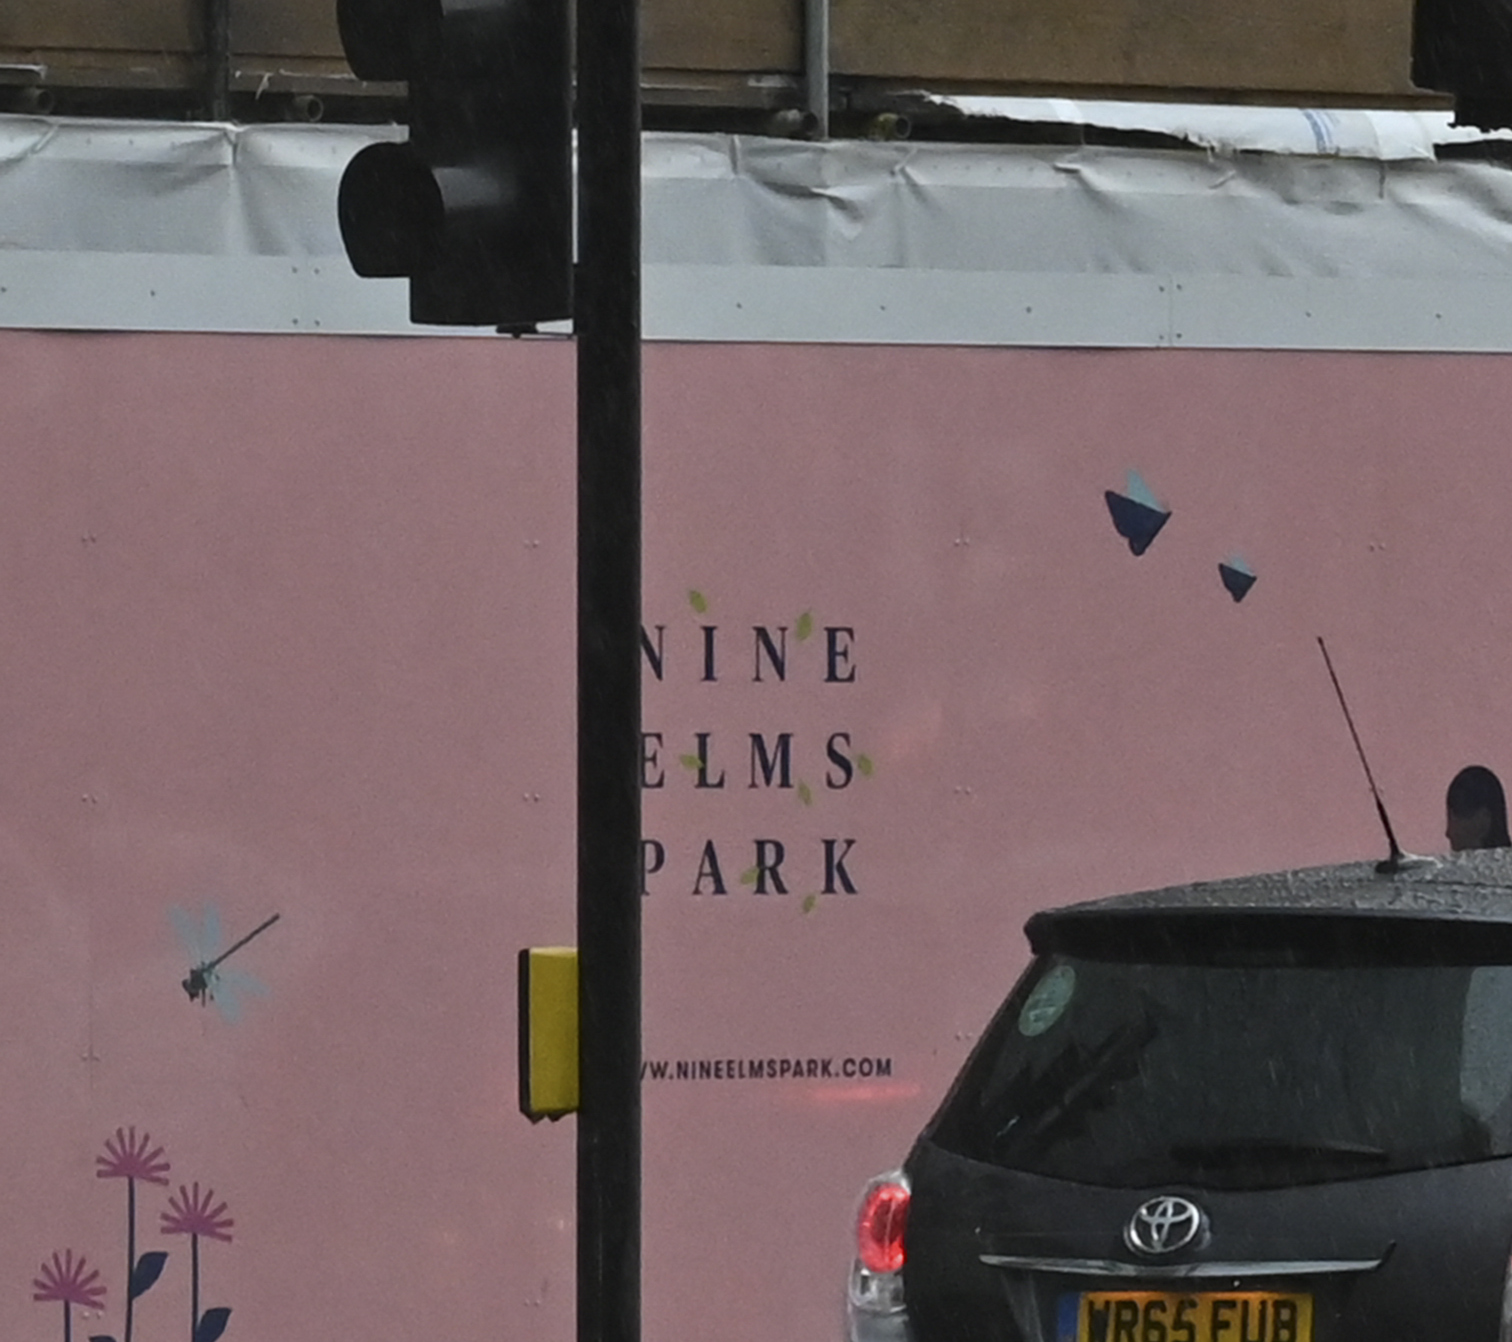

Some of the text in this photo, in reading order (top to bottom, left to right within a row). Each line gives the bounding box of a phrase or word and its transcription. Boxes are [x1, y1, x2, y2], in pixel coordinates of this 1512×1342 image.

[641, 625, 857, 683] NINE
[641, 732, 854, 789] ELMS
[641, 838, 859, 896] PARK
[641, 1057, 892, 1081] W.NINEELMSPARK.COM
